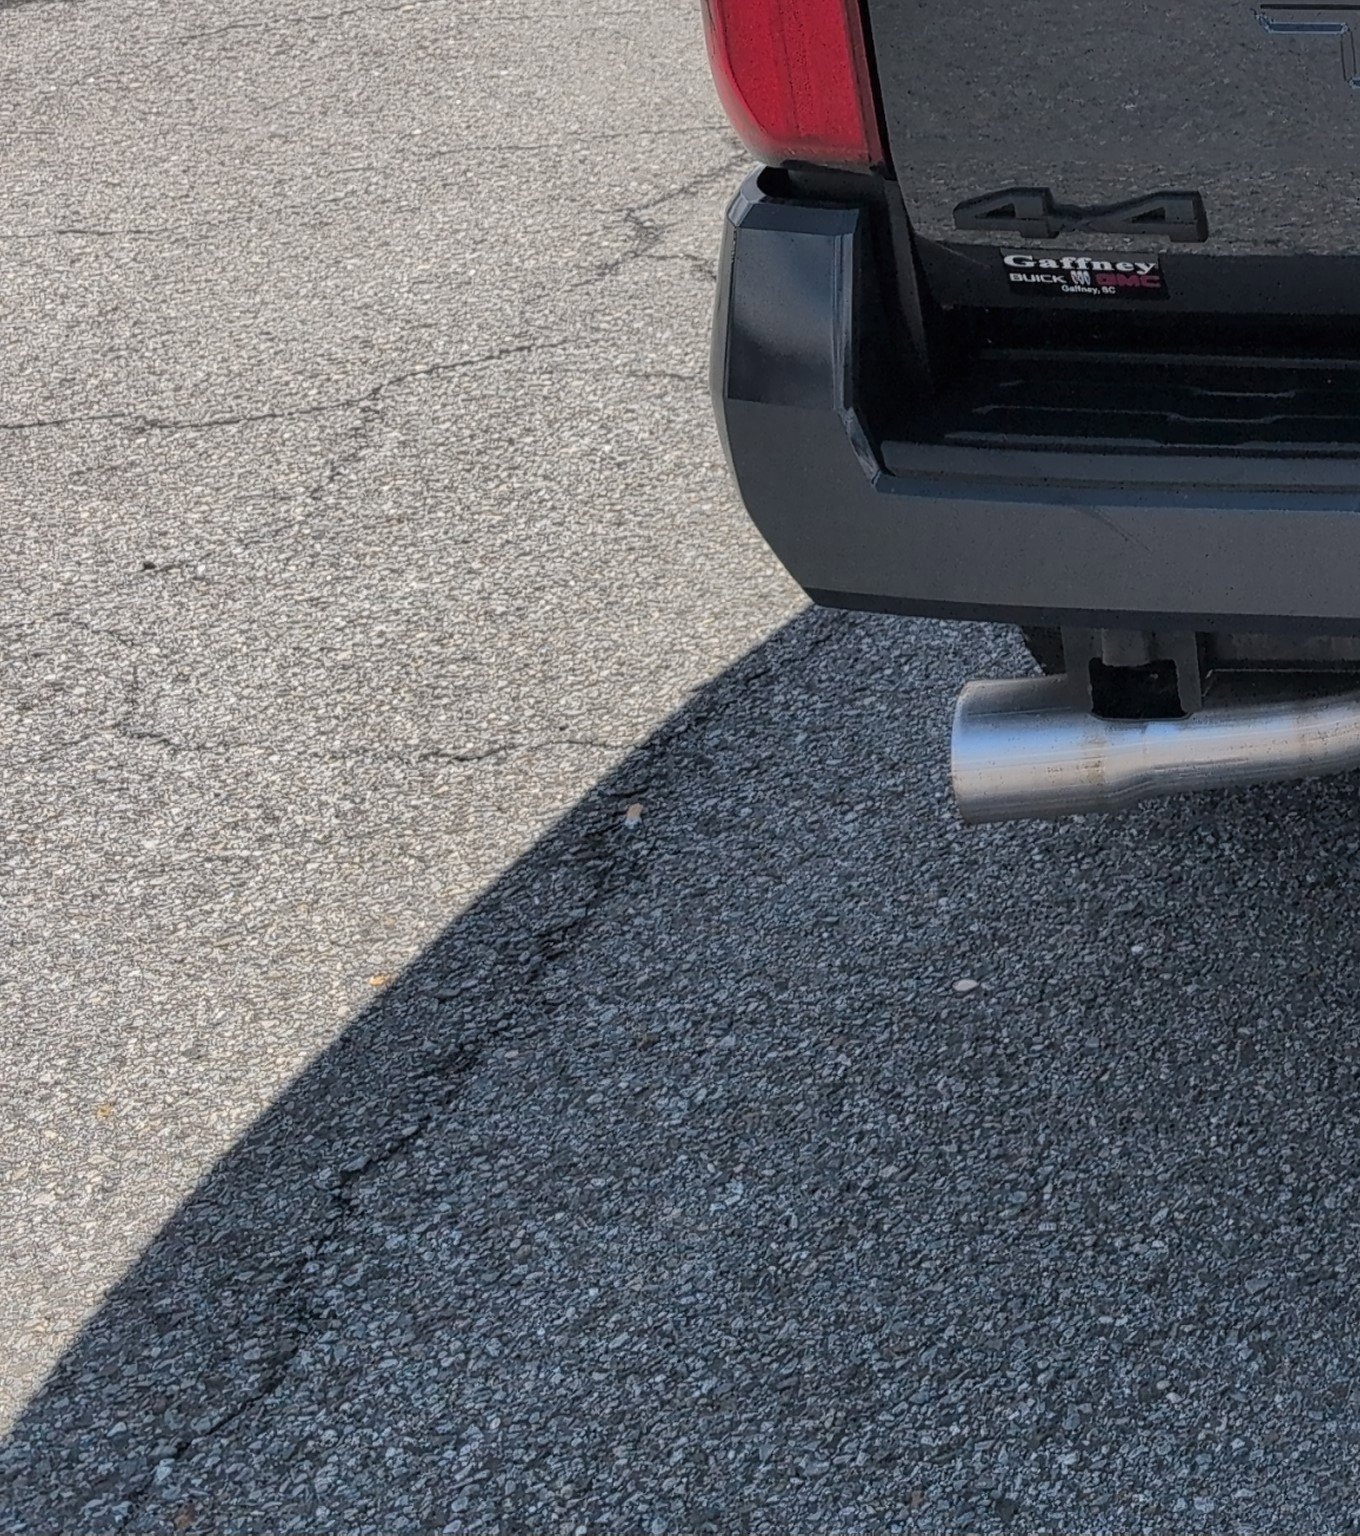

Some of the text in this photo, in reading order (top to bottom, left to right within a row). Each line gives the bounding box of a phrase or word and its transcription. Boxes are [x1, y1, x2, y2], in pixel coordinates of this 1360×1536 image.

[1003, 254, 1157, 276] Gaffney
[1009, 272, 1161, 289] BUICK GMC
[1061, 284, 1116, 295] Gaffney, SC
